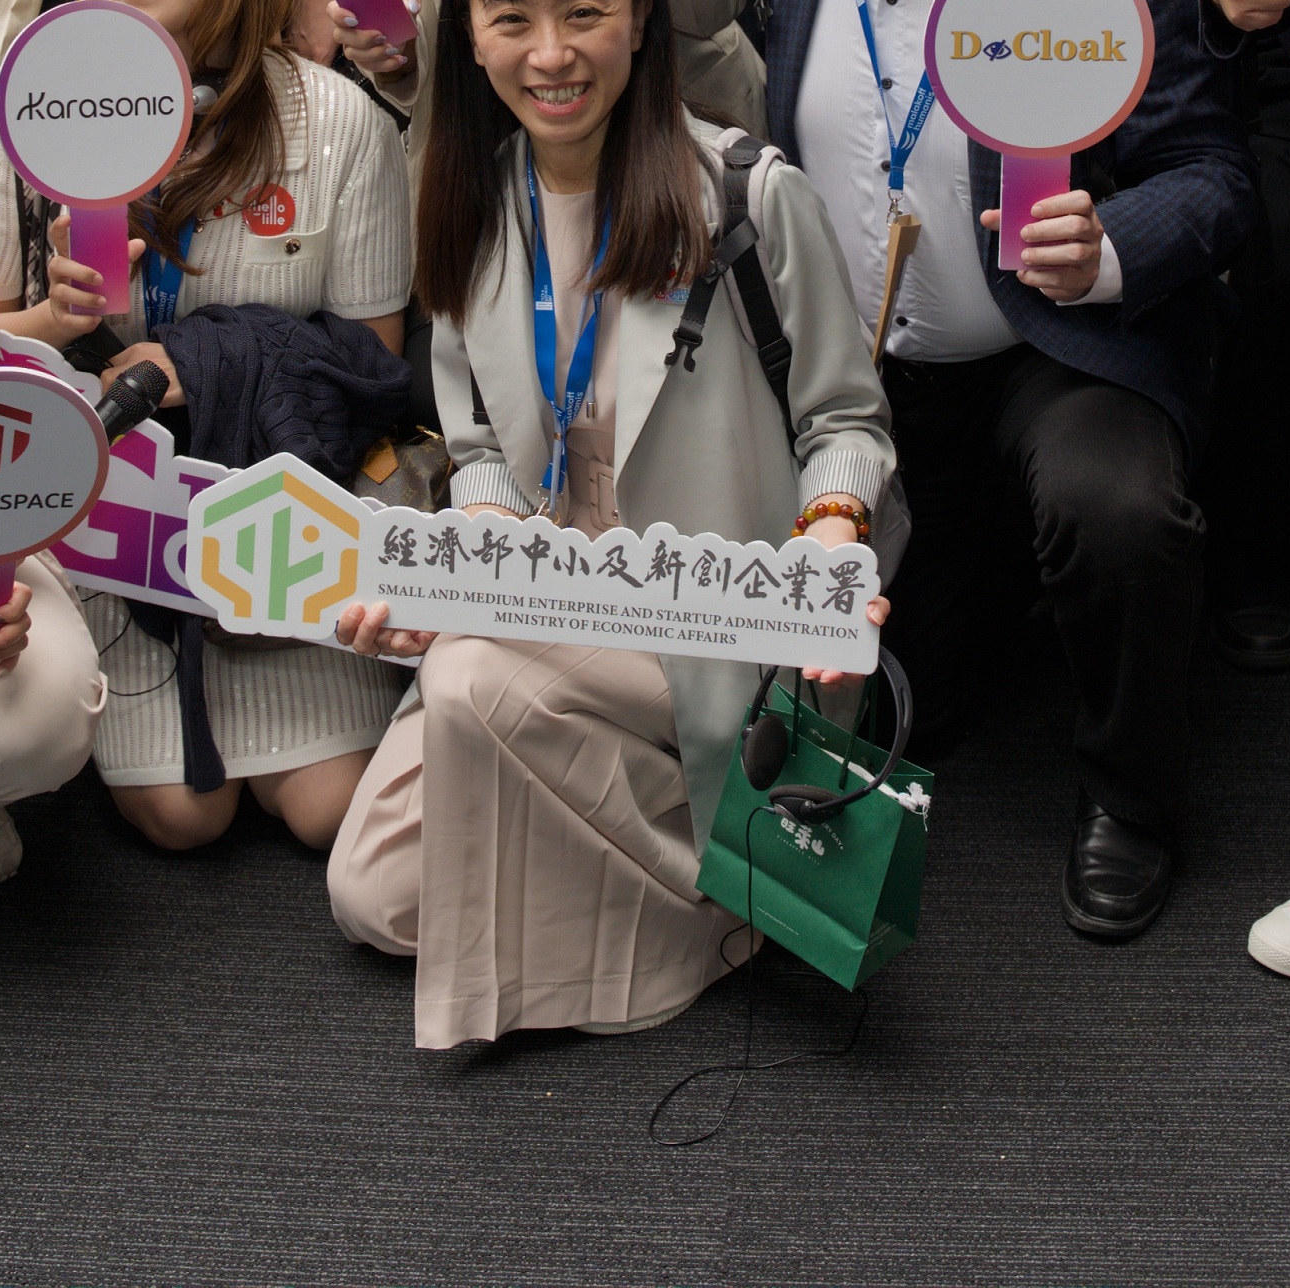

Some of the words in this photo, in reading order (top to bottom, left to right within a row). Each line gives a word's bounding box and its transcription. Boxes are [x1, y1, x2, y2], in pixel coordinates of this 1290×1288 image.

[949, 29, 1128, 62] DCloak
[16, 91, 175, 121] Karasonic
[907, 87, 927, 129] malakoff
[913, 91, 935, 131] humanis
[261, 212, 286, 225] lille
[165, 293, 176, 324] umanis
[0, 493, 74, 510] SPACE
[378, 525, 865, 615] 經濟部中小及新創企業署
[378, 583, 426, 598] SMALL
[428, 588, 460, 601] AND
[462, 591, 525, 607] MEDIUM
[528, 597, 618, 616] ENTERPRISE
[620, 606, 653, 619] AND
[655, 609, 722, 626] STARTUP
[723, 616, 859, 640] ADMINISTRATION
[494, 611, 567, 628] MINISTRY
[569, 618, 589, 630] OF
[592, 620, 675, 639] ECONOMIC
[677, 630, 737, 645] AFFAIRS
